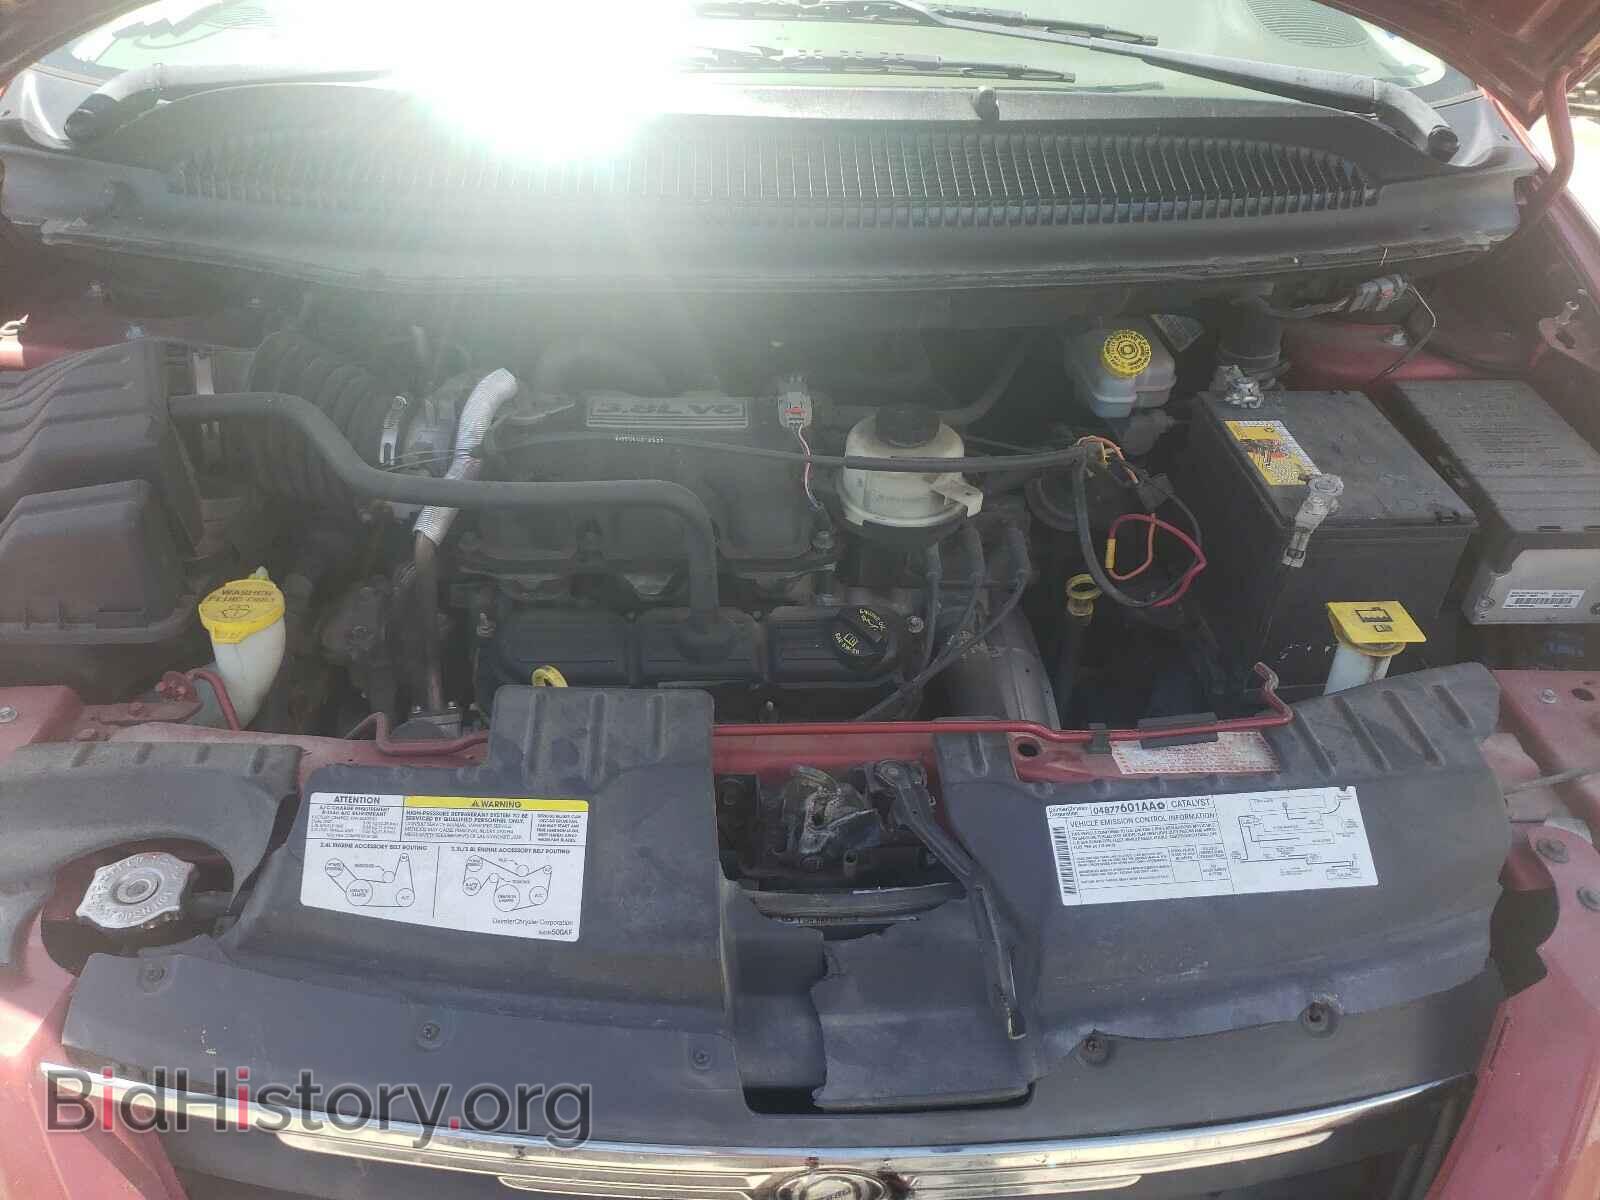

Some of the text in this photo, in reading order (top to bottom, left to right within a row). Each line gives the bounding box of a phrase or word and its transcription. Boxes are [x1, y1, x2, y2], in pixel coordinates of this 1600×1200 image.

[334, 795, 380, 804] ATTENTION
[481, 800, 522, 808] WARNING
[1170, 799, 1210, 809] CATALYST
[1093, 801, 1157, 815] 04877601AA
[1070, 812, 1215, 828] VEHICLE EMISSION CONTROL INFORMATION
